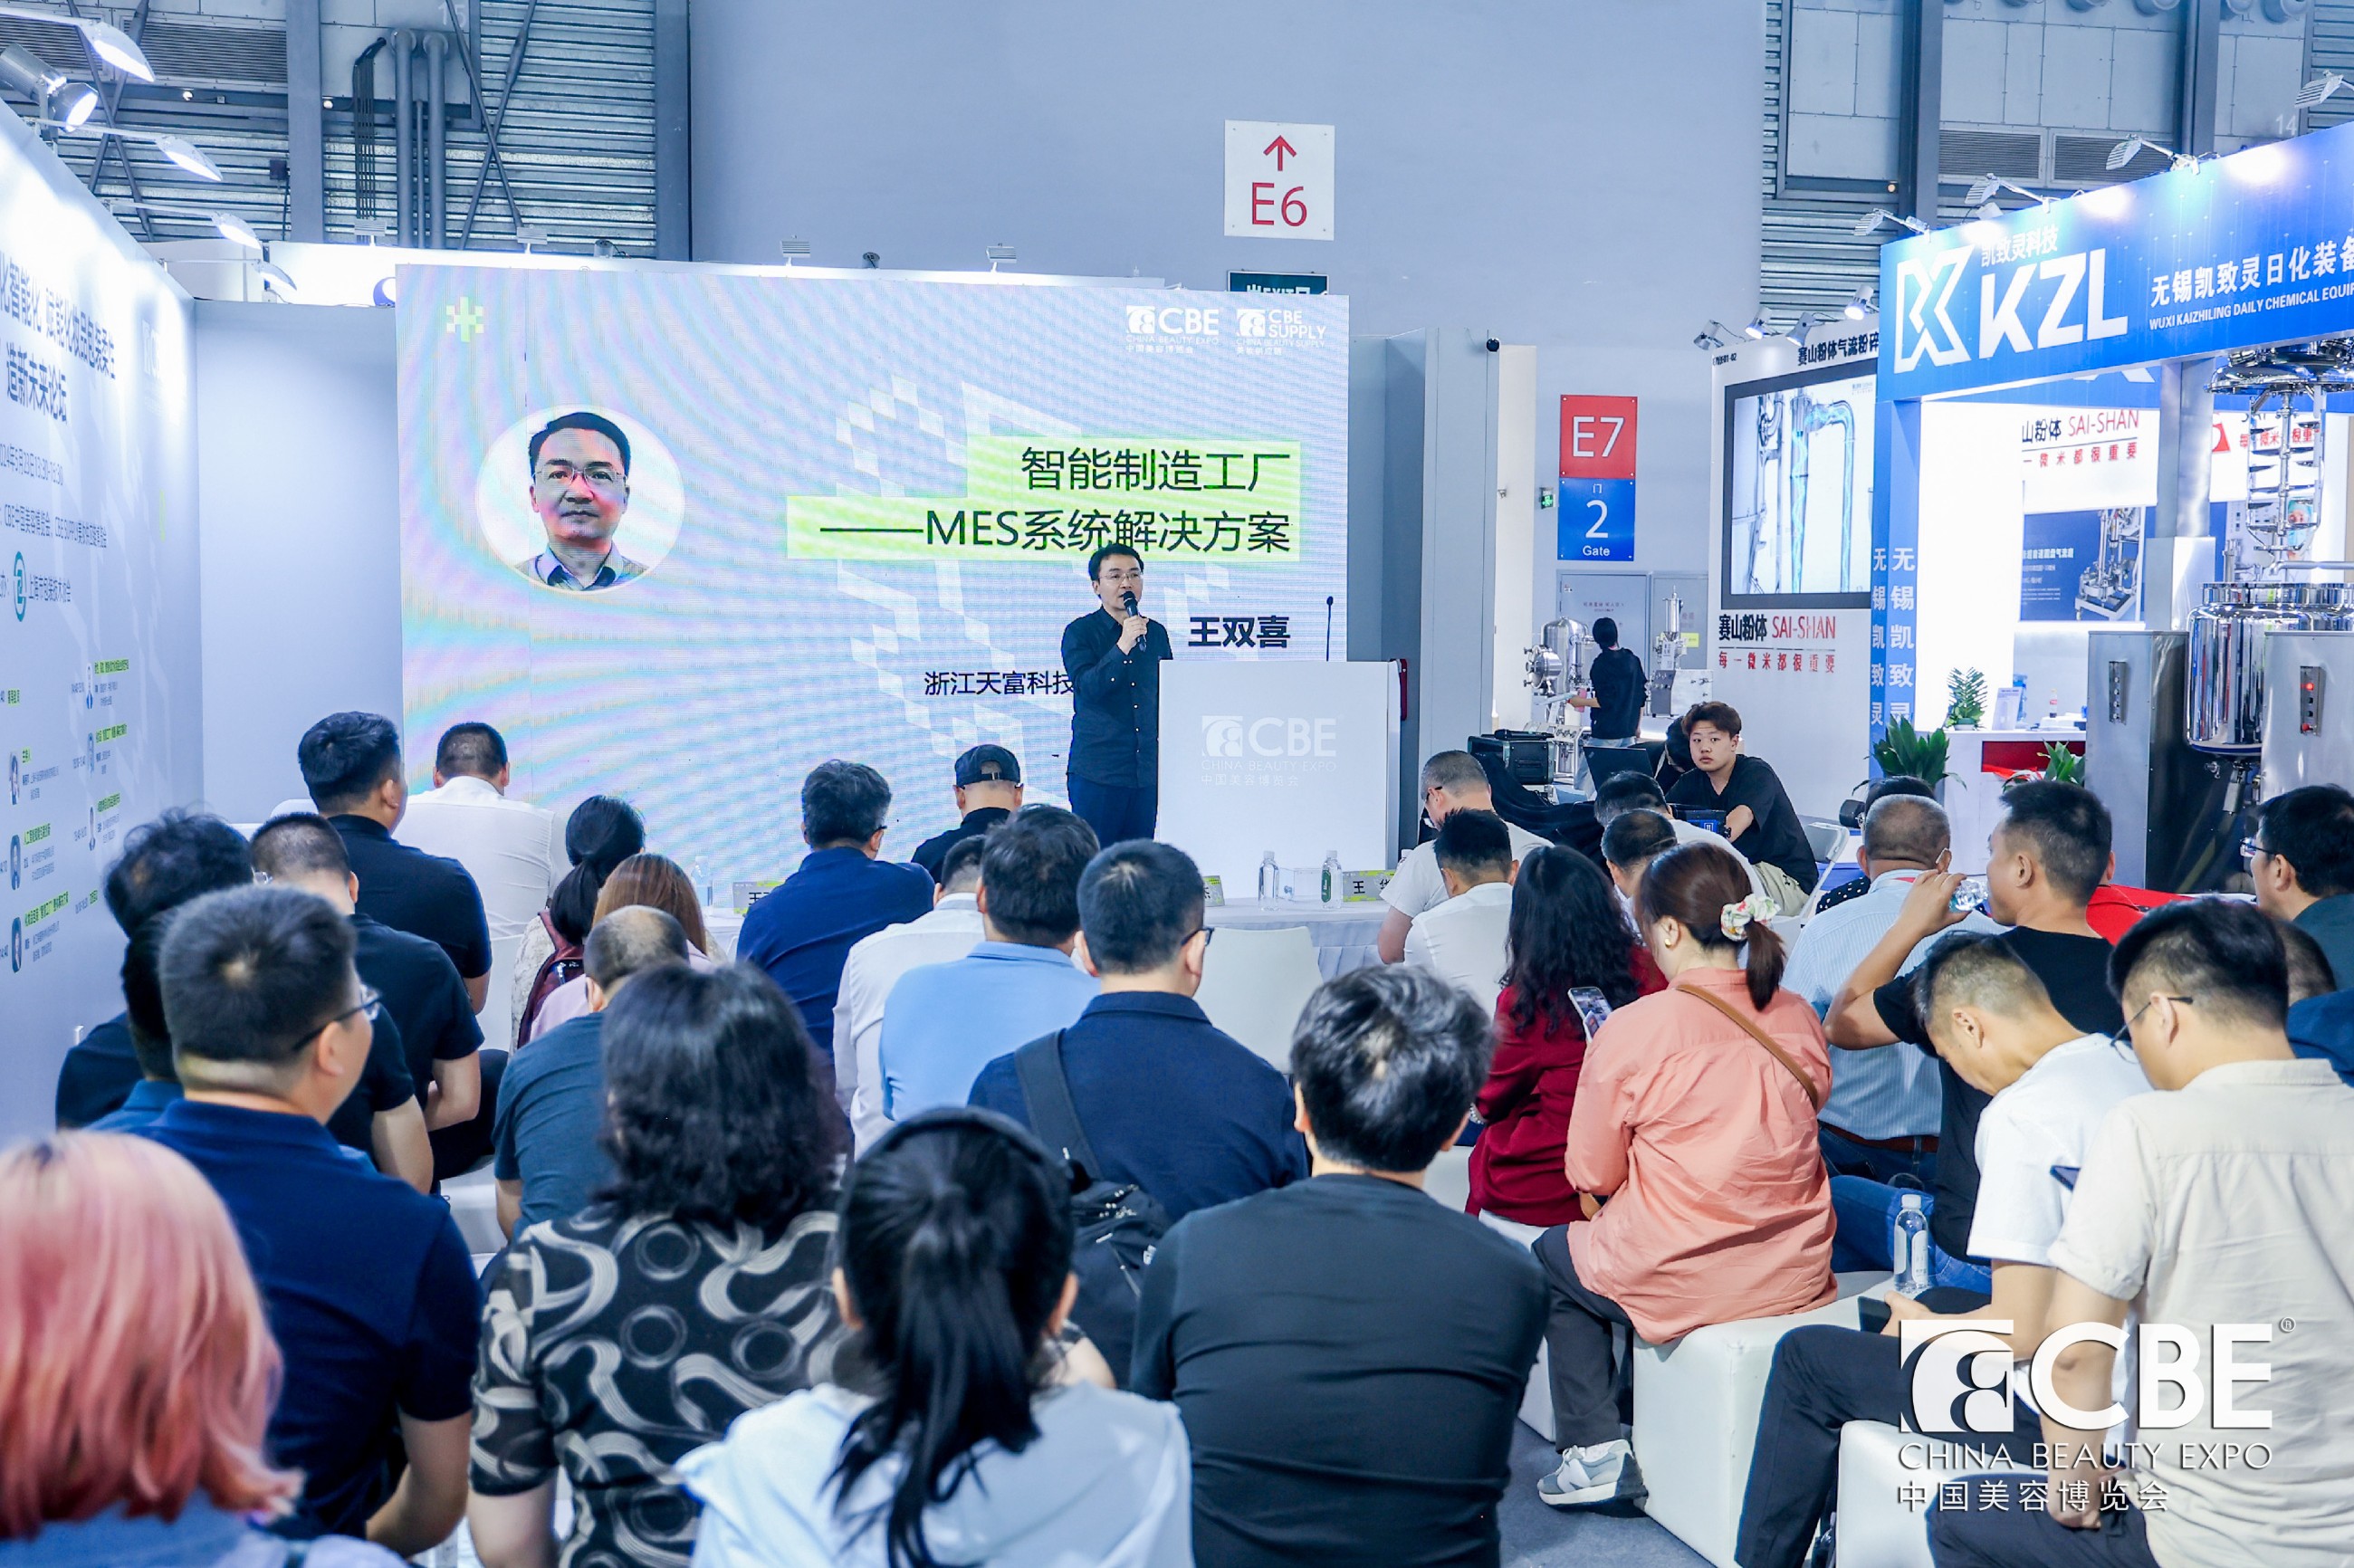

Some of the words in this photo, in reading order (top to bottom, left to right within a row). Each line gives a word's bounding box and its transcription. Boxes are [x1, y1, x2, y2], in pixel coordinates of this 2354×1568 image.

[2275, 114, 2298, 136] 14
[1251, 182, 1307, 227] E6
[1982, 225, 2060, 268] 凯致灵科技
[2149, 235, 2354, 309] 无锡凯致灵日化装备
[1268, 309, 1303, 325] CBE
[1978, 248, 2128, 359] KZL
[2148, 314, 2176, 330] WUXI
[2176, 304, 2232, 326] KAIZHILING
[2233, 299, 2265, 317] DAILY
[2265, 289, 2321, 311] CHEMICAL
[1158, 307, 1220, 336] CBE
[1268, 324, 1326, 339] SUPPLY
[1125, 335, 1155, 344] CHINA
[1159, 336, 1192, 345] BEAUTY
[1195, 337, 1220, 346] EXPO
[1125, 344, 1194, 355] 中国美容博览会
[1236, 339, 1262, 347] CHINA
[1265, 339, 1294, 348] BEAUTY
[1295, 339, 1325, 349] SUPPLY
[1797, 331, 1880, 367] 赛山粉体气流粉碎
[1572, 416, 1625, 458] E7
[2022, 416, 2062, 444] 山粉体
[2068, 409, 2139, 437] SAI-SHAN
[1020, 445, 1291, 492] 智能制造工厂
[1593, 483, 1603, 494] 门
[1584, 499, 1610, 539] 2
[1582, 545, 1611, 558] Gate
[1187, 615, 1291, 649] 王双喜
[1718, 614, 1767, 642] 赛山粉体
[1772, 616, 1836, 639] SAI-SHAN
[1871, 547, 1887, 726] 无锡凯致灵
[1889, 547, 1916, 724] 无锡凯致灵
[1718, 651, 1835, 674] 每一微米都很重要
[923, 670, 1074, 696] 浙江天富科技
[1248, 716, 1337, 757] CBE
[1201, 760, 1243, 771] CHINA
[1249, 760, 1297, 771] BEAUTY
[1302, 760, 1337, 772] EXPO
[1201, 773, 1299, 787] 中国美容博览会
